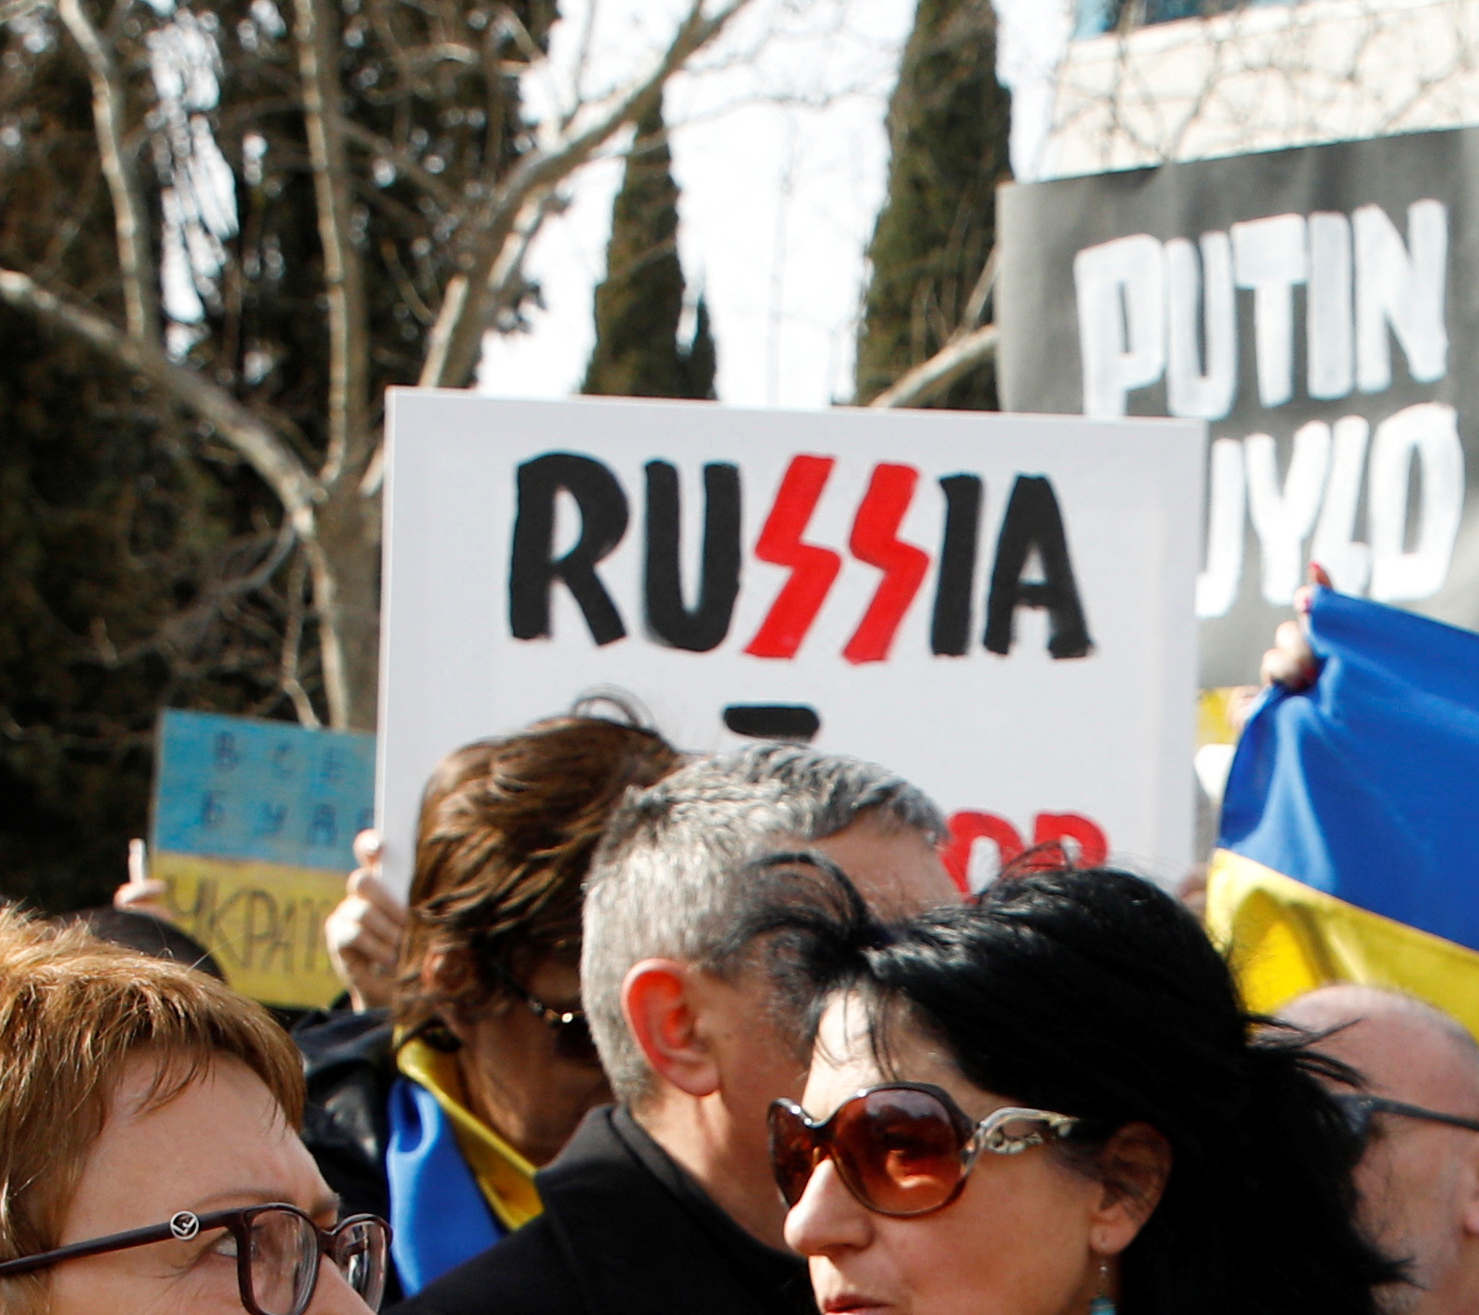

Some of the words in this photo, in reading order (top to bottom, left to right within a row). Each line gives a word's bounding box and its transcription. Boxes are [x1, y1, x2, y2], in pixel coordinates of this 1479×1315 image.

[1074, 198, 1449, 418] PUTIN
[508, 452, 1097, 664] RUSSIA
[1195, 401, 1464, 620] UYLO
[166, 874, 336, 976] УКРАЇ
